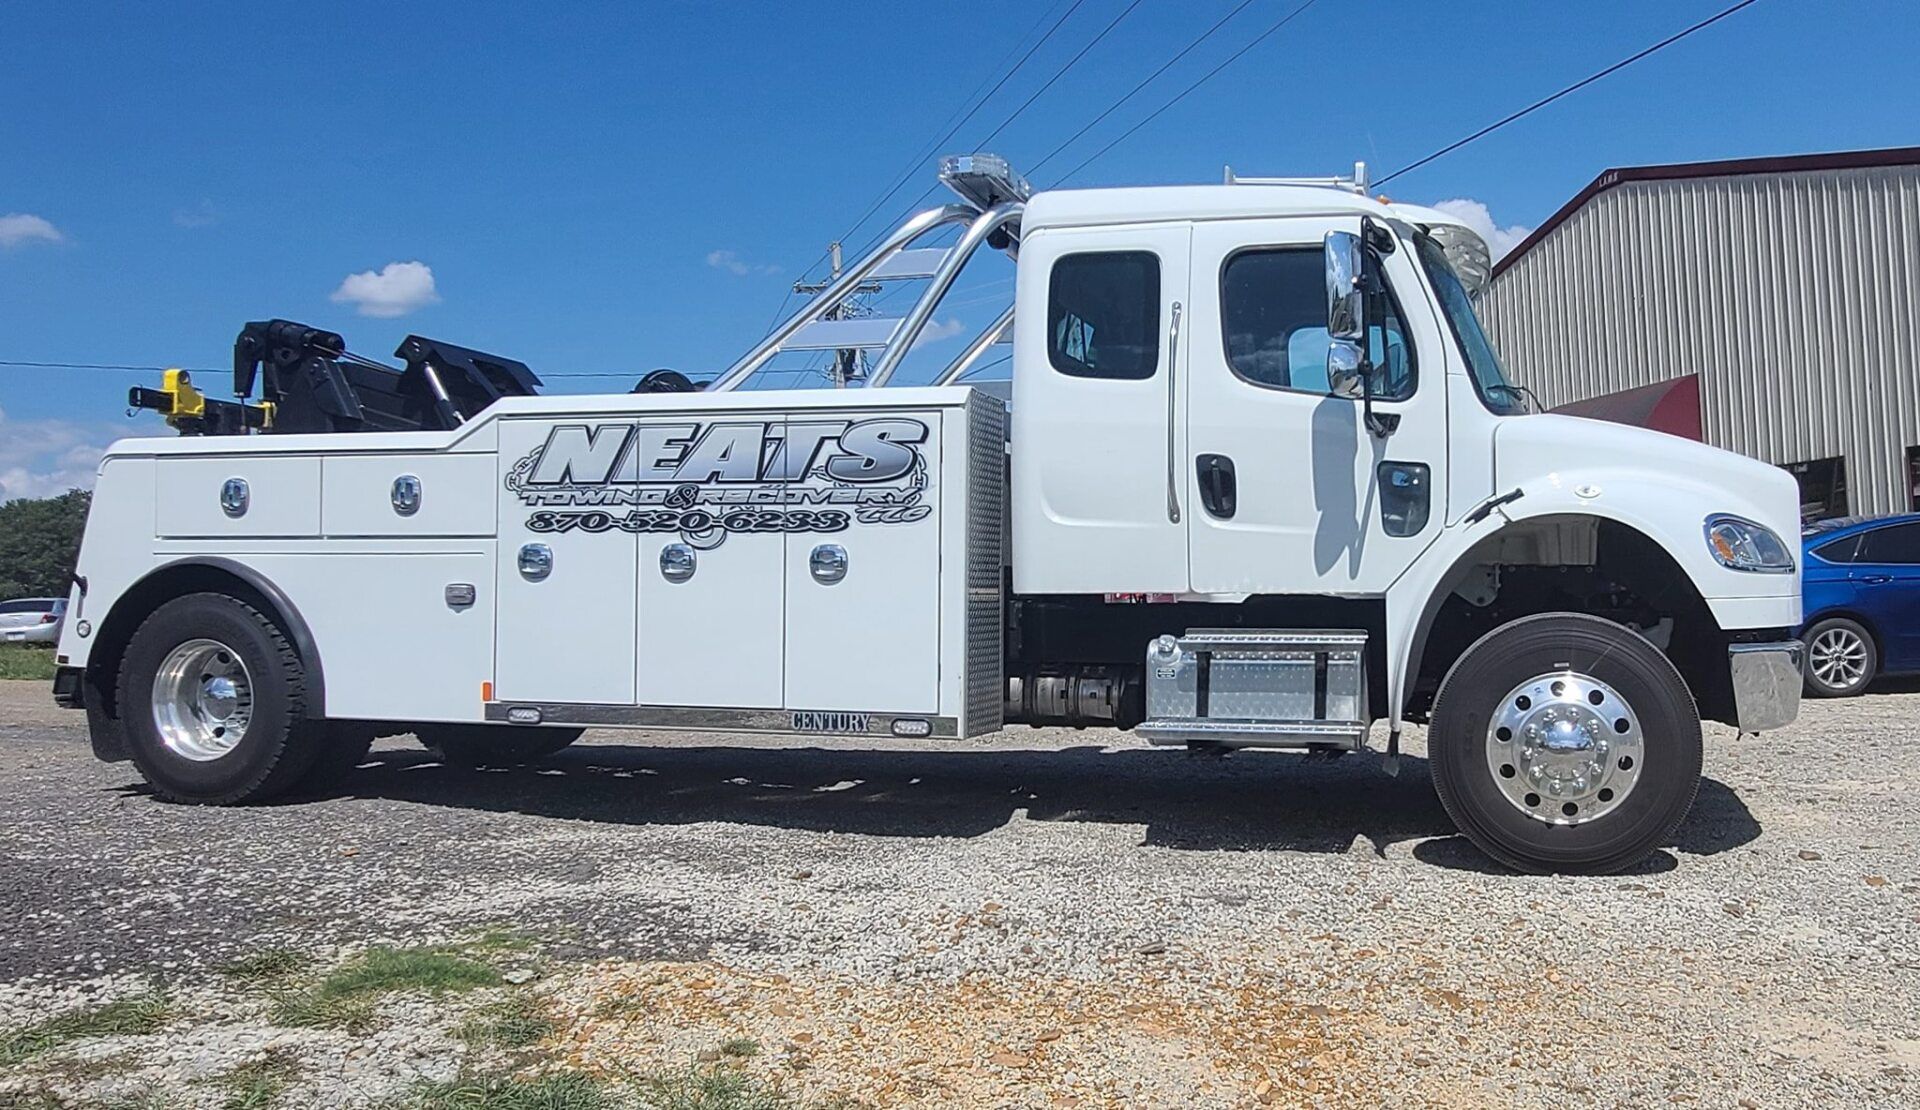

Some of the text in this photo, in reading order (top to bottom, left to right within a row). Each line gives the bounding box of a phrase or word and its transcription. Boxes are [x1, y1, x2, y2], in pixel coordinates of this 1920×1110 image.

[527, 418, 929, 484] NEATS
[519, 484, 924, 509] TOWING & RECOVERY
[525, 510, 850, 533] 870-520-6233
[855, 505, 932, 523] LLC
[792, 711, 871, 732] CENTURY
